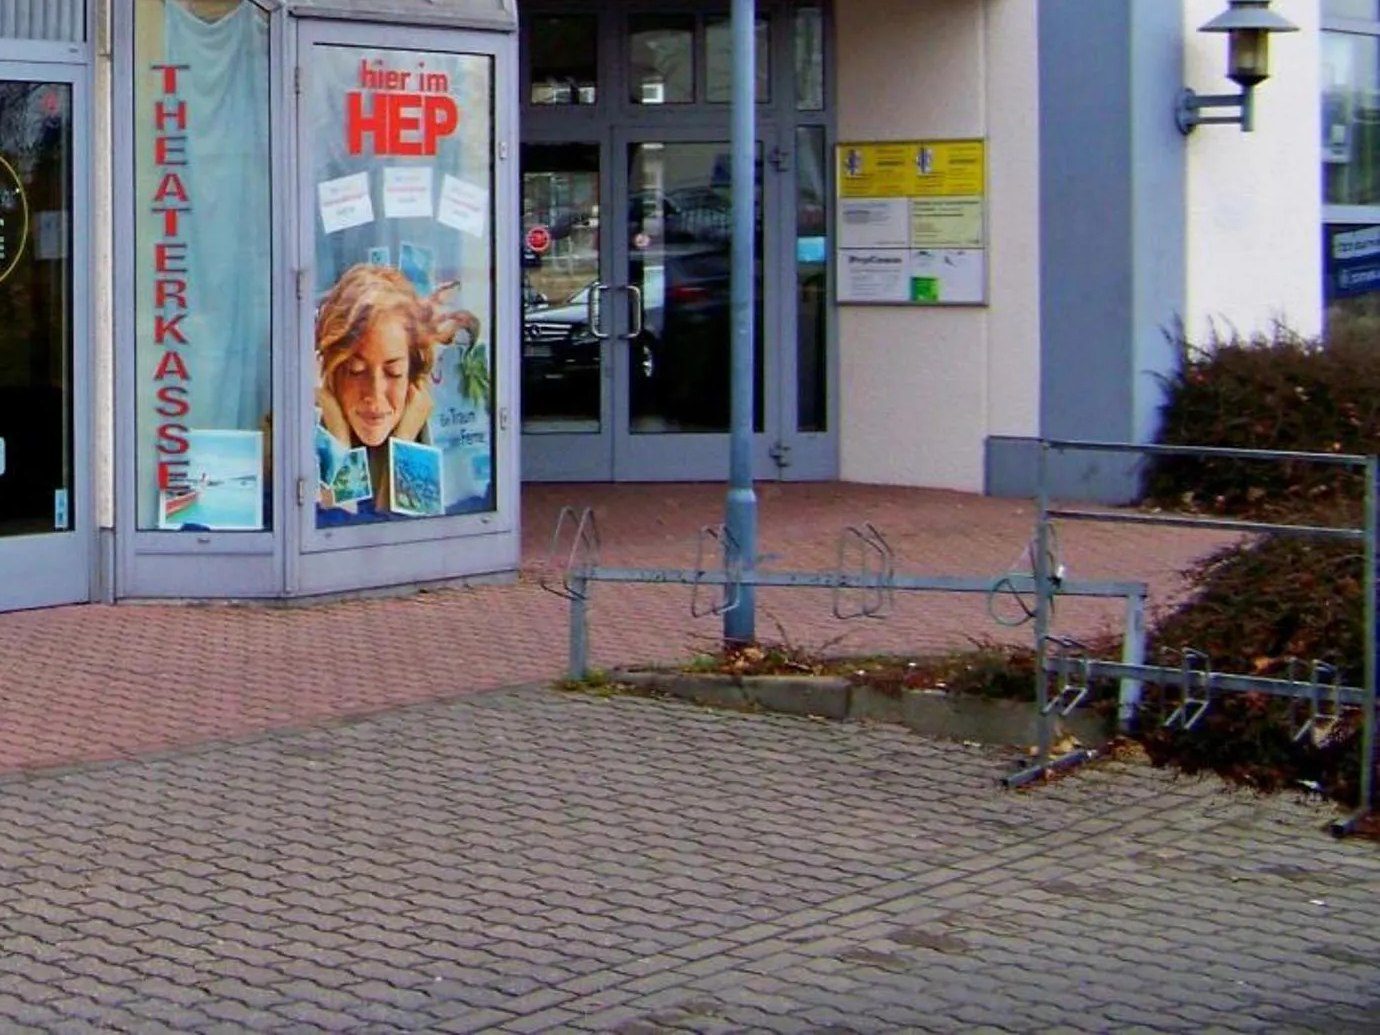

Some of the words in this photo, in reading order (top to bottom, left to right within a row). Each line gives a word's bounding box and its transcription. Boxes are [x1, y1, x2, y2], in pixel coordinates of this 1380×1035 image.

[360, 57, 410, 92] hier
[419, 60, 450, 92] im
[344, 91, 460, 158] HEP
[150, 63, 191, 493] THEATERKASSE
